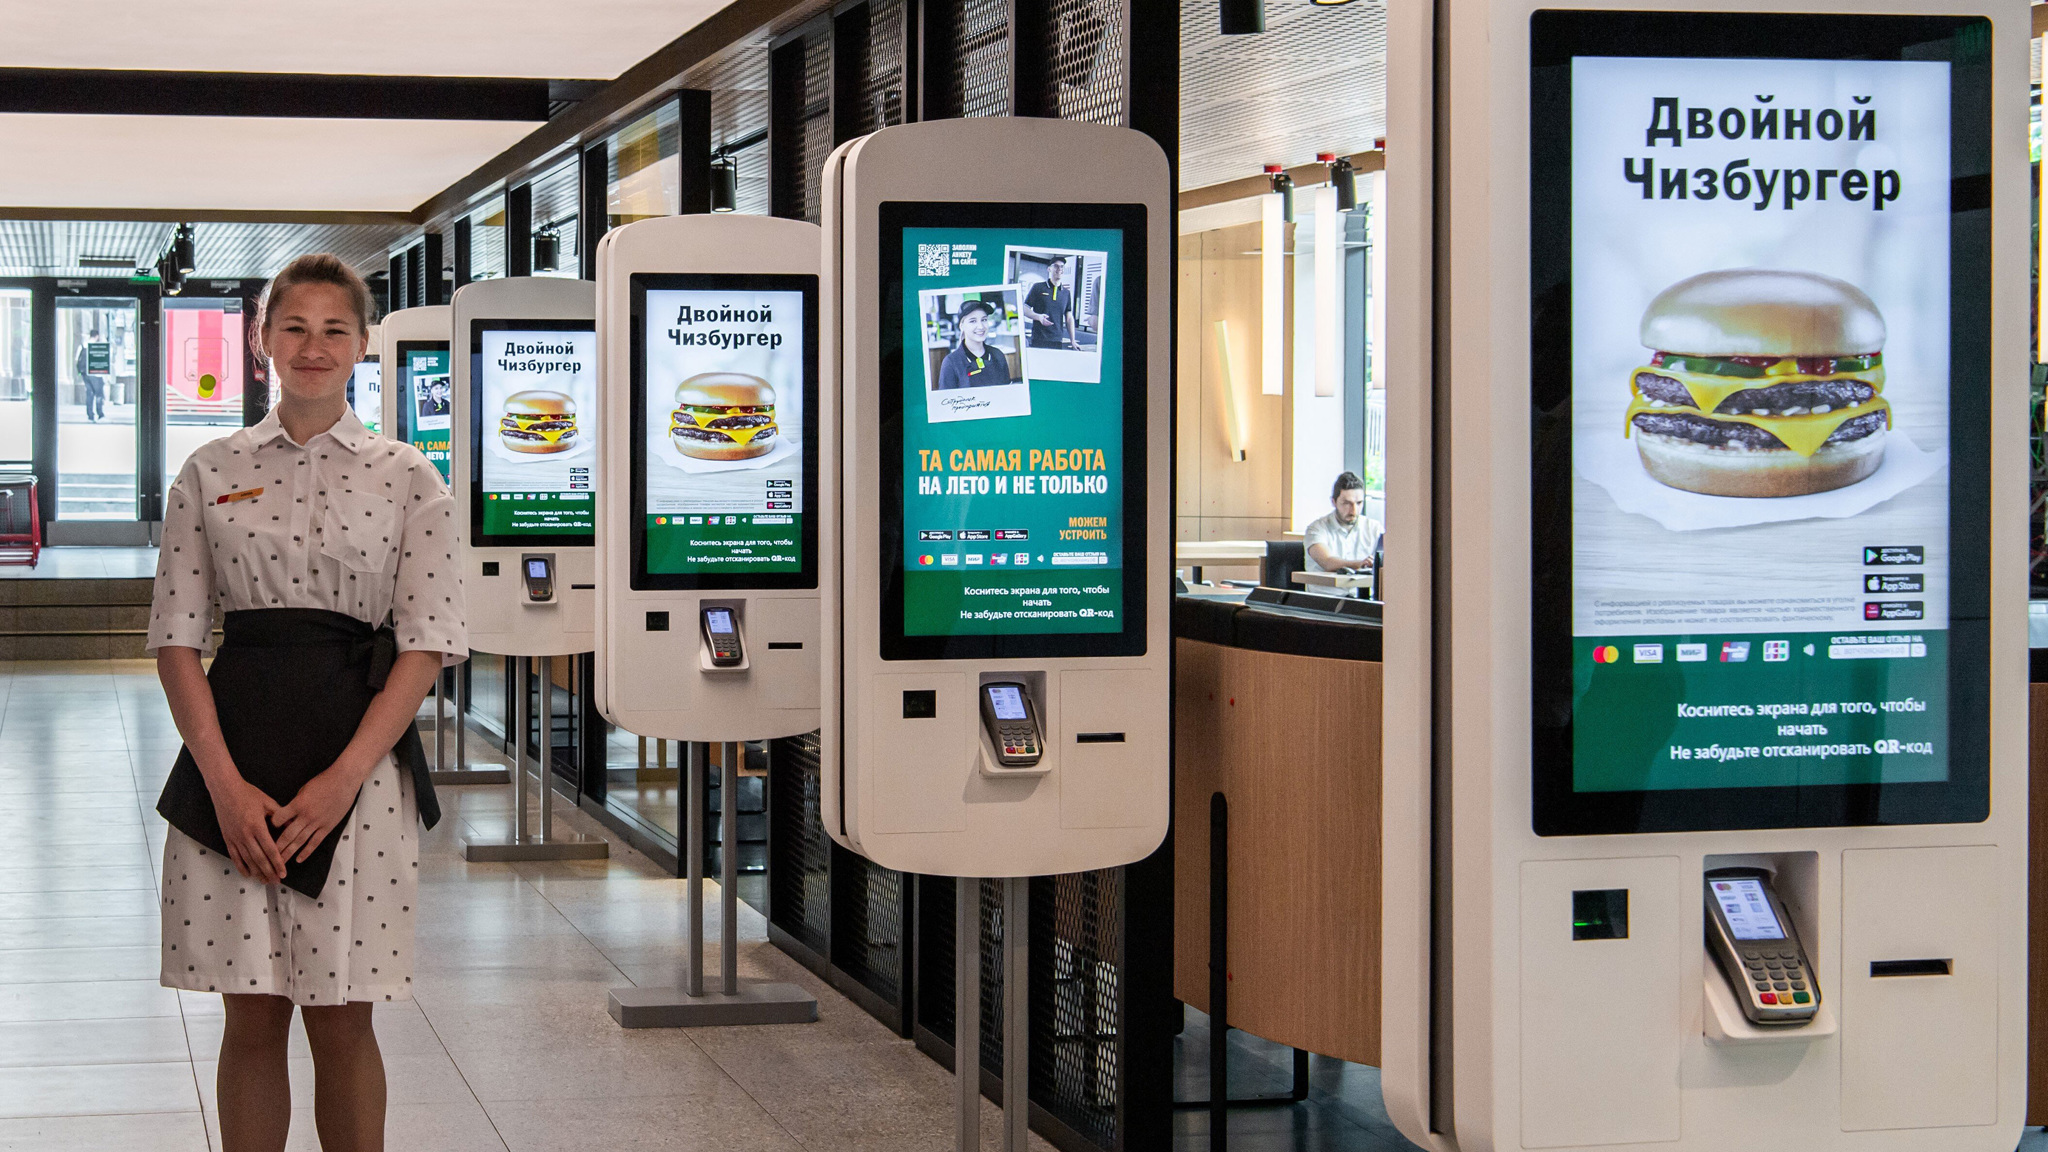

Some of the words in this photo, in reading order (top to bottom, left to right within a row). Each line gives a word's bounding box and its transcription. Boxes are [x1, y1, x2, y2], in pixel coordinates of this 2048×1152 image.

[1646, 95, 1876, 147] Двойной
[1623, 157, 1901, 211] Чизбургер
[677, 305, 772, 325] Двойной
[668, 329, 782, 350] Чизбургер
[505, 342, 574, 356] Двойной
[498, 359, 581, 374] Чизбургер
[919, 449, 943, 472] ТА
[950, 449, 1021, 472] САМАЯ
[1029, 449, 1106, 472] РАБОТА
[918, 476, 942, 495] НА
[946, 476, 990, 495] ЛЕТО
[995, 476, 1007, 494] И
[1013, 476, 1035, 494] НЕ
[1039, 475, 1108, 494] ТОЛЬКО
[1069, 517, 1107, 527] МОЖЕМ
[1059, 530, 1107, 541] УСТРОИТЬ
[1880, 553, 1906, 563] Google
[1906, 553, 1922, 563] Play
[964, 587, 1009, 596] Коснитесь
[1010, 587, 1040, 597] экрана
[1042, 586, 1058, 595] для
[1059, 586, 1081, 595] того,
[1082, 585, 1110, 594] чтобы
[1881, 582, 1898, 592] App
[1898, 582, 1920, 590] Store
[960, 610, 972, 619] Не
[974, 610, 1012, 620] забудьте
[1014, 609, 1078, 620] отсканировать
[1079, 608, 1114, 618] QR-код
[1881, 609, 1922, 618] AppGallery
[1638, 649, 1657, 657] VISA
[1677, 703, 1754, 718] Коснитесь
[1756, 703, 1808, 719] экрана
[1810, 702, 1838, 716] для
[1840, 702, 1877, 714] того,
[1880, 697, 1926, 712] чтобы
[1777, 724, 1828, 736] начать
[1670, 745, 1692, 760] Не
[1694, 744, 1760, 763] забудьте
[1762, 744, 1872, 760] отсканировать
[1874, 739, 1933, 755] QR-код
